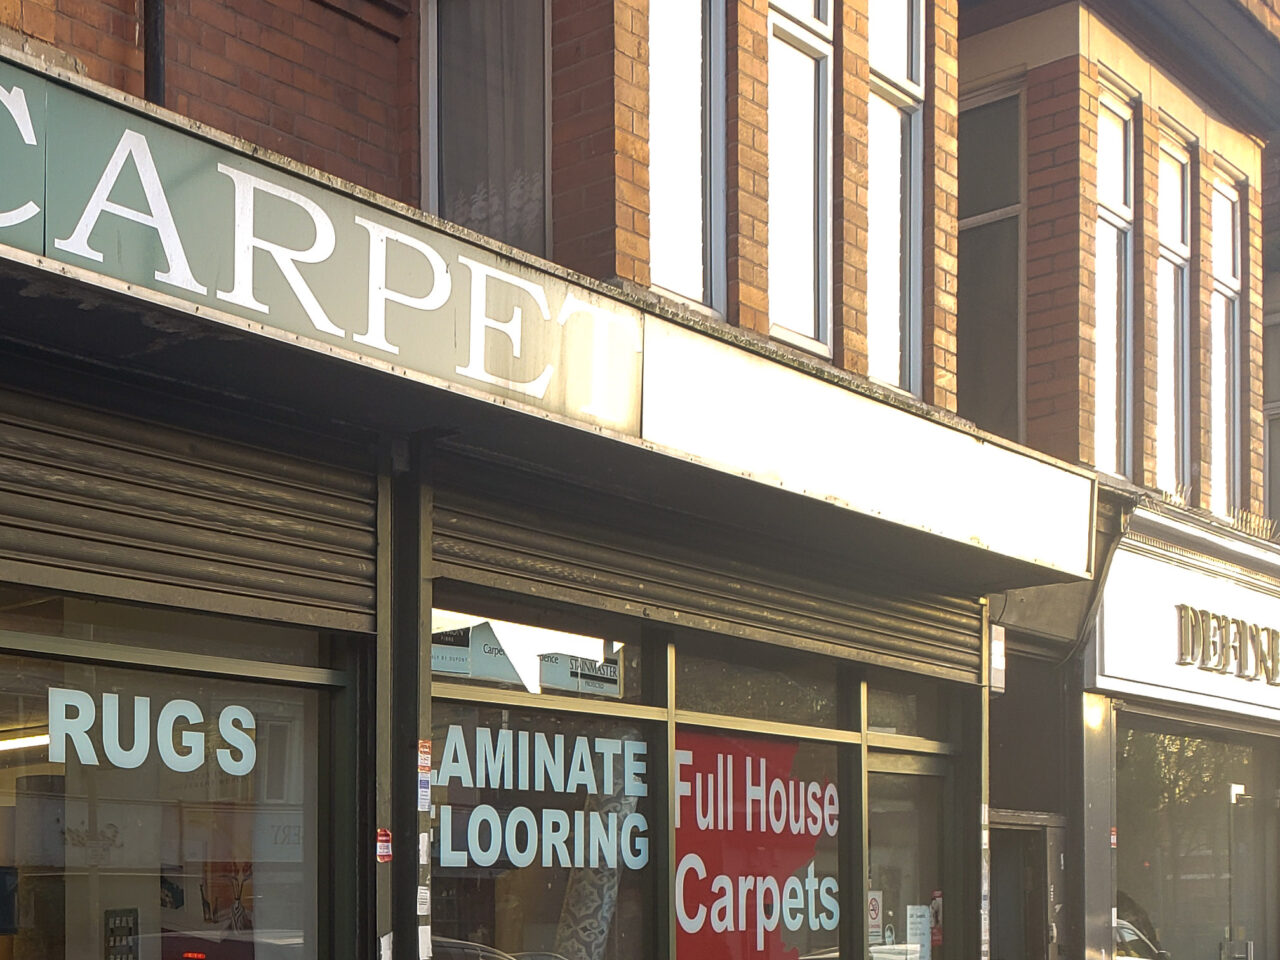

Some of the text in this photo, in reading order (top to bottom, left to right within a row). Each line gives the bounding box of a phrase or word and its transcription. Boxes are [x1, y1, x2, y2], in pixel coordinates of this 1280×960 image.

[569, 657, 618, 678] STAINMASTER
[48, 687, 257, 776] RUGS
[431, 724, 648, 797] AMINATE
[674, 749, 840, 837] Full House
[675, 853, 840, 951] Carpets
